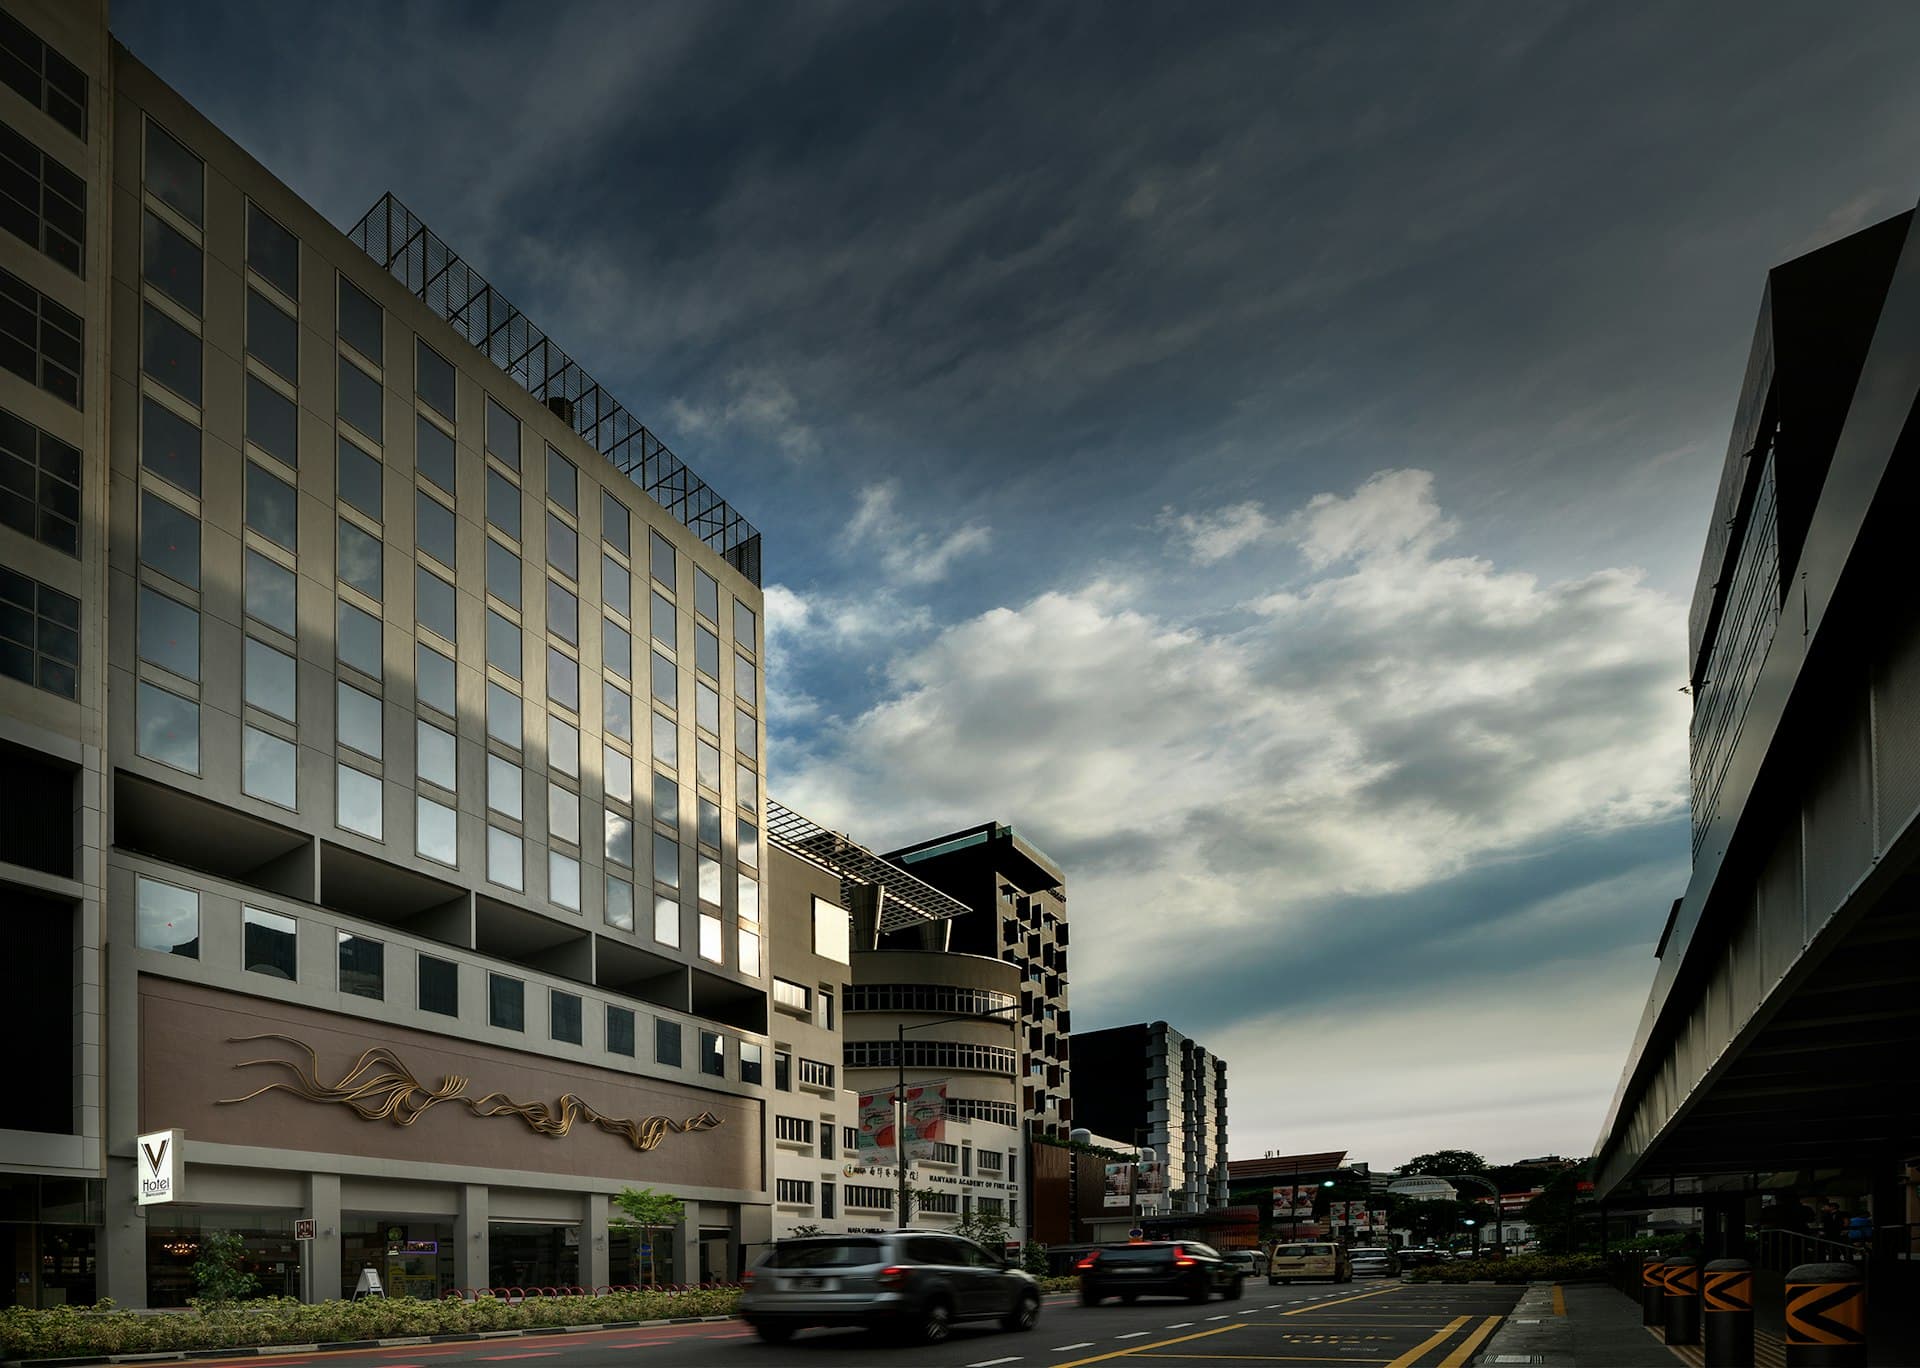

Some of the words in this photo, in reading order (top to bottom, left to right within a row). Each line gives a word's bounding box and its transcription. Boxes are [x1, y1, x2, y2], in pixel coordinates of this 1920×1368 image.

[141, 1138, 170, 1178] V
[143, 1177, 169, 1191] Hotel
[929, 1175, 957, 1184] NANYANG
[958, 1178, 984, 1188] ACADEMY
[993, 1182, 1005, 1190] FINE
[1006, 1183, 1019, 1191] ARTS
